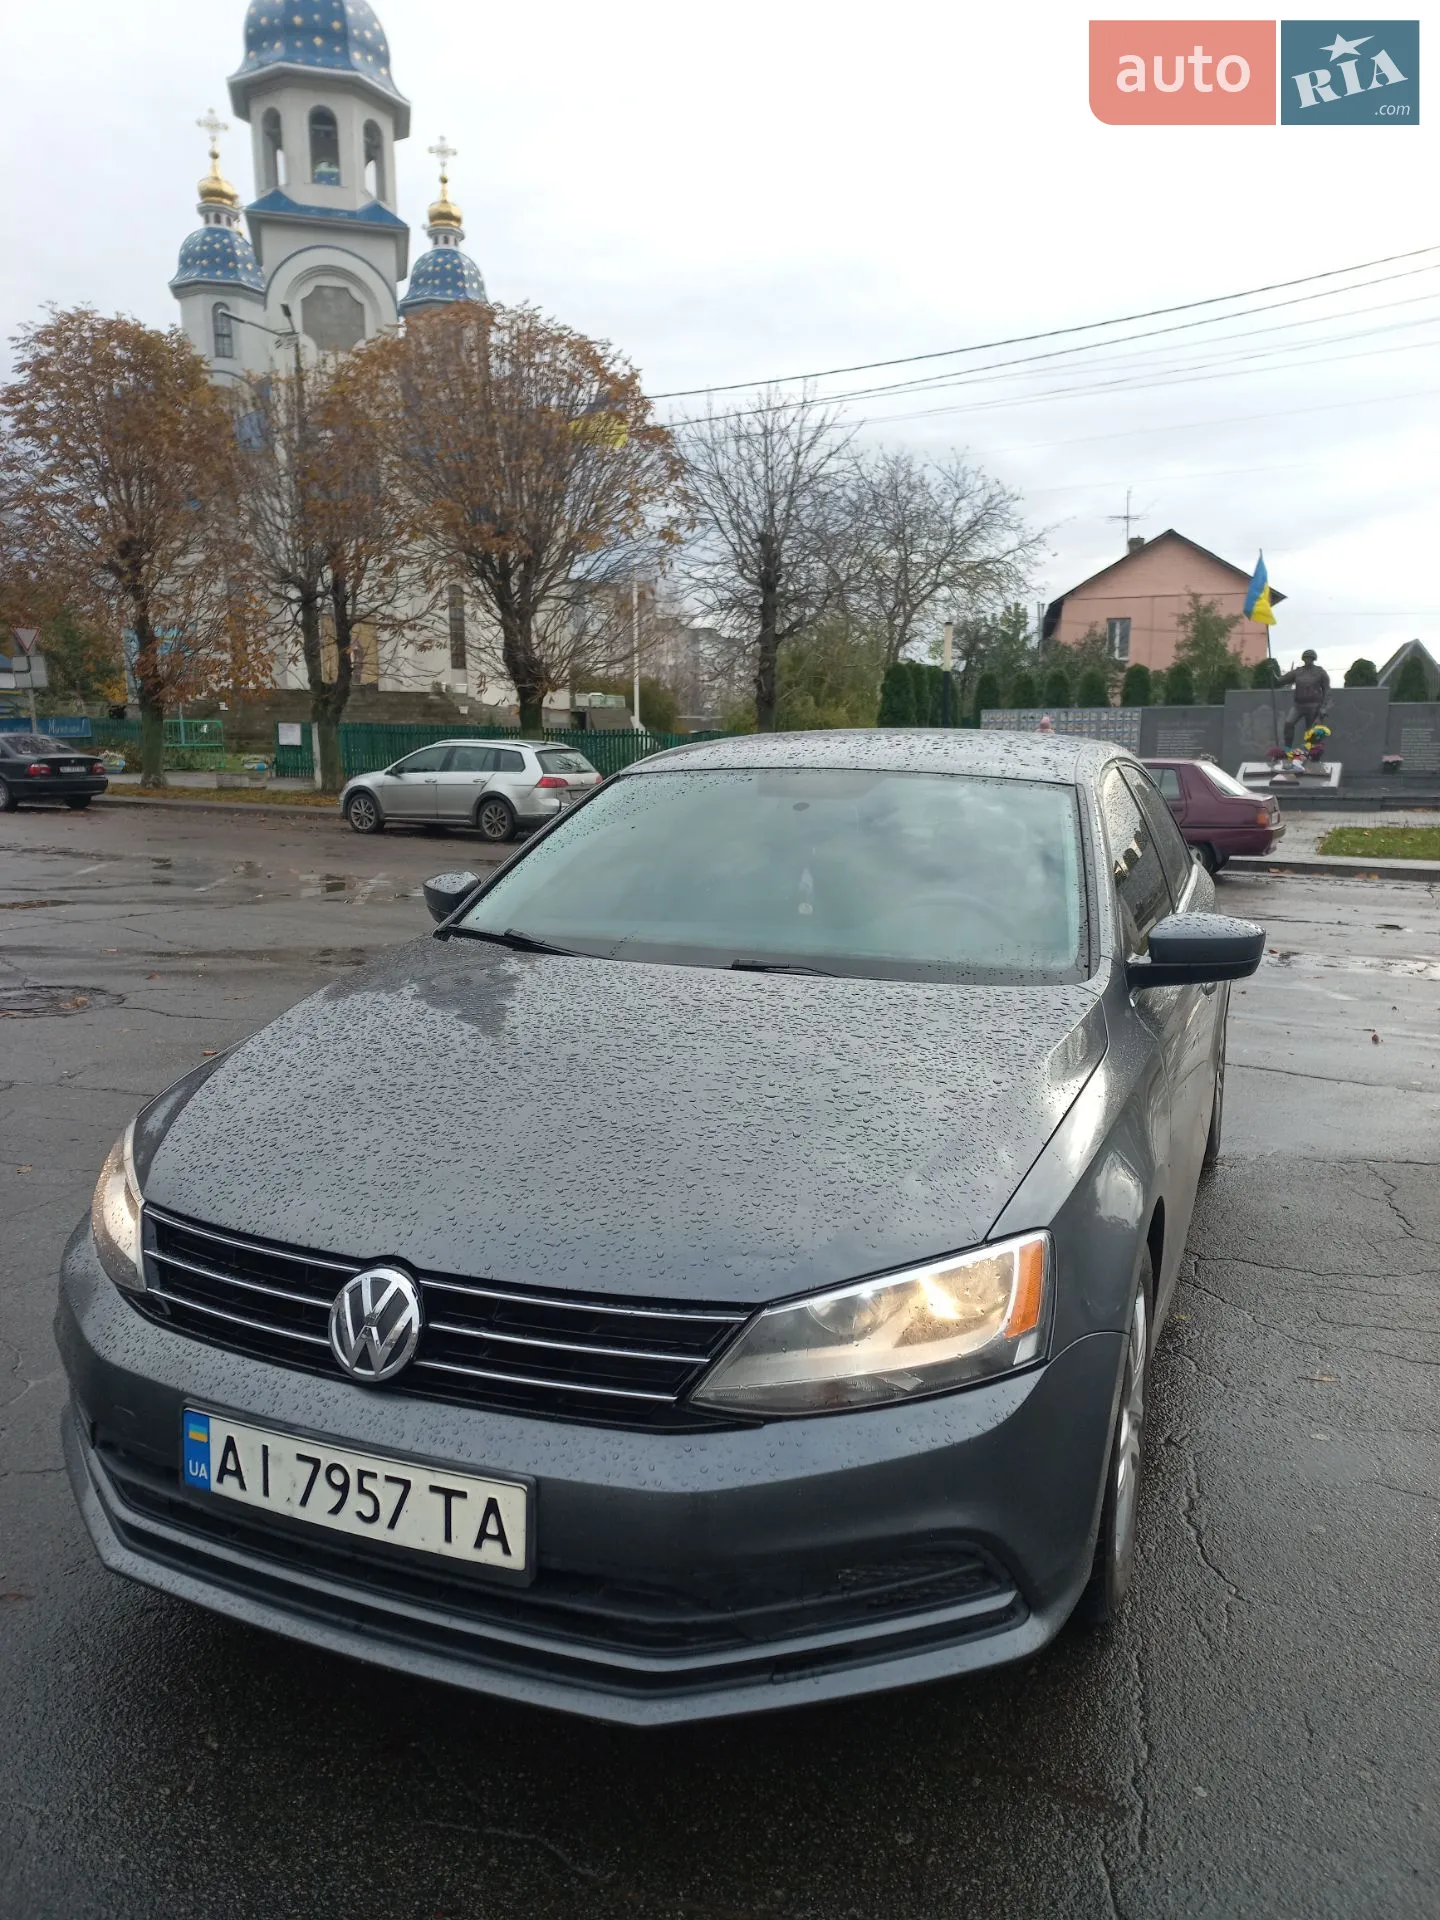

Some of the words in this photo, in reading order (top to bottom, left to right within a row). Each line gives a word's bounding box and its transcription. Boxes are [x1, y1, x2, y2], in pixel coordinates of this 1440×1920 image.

[187, 1458, 208, 1480] UA
[215, 1434, 271, 1498] AI
[295, 1452, 412, 1530] 7957
[428, 1484, 513, 1557] TA
